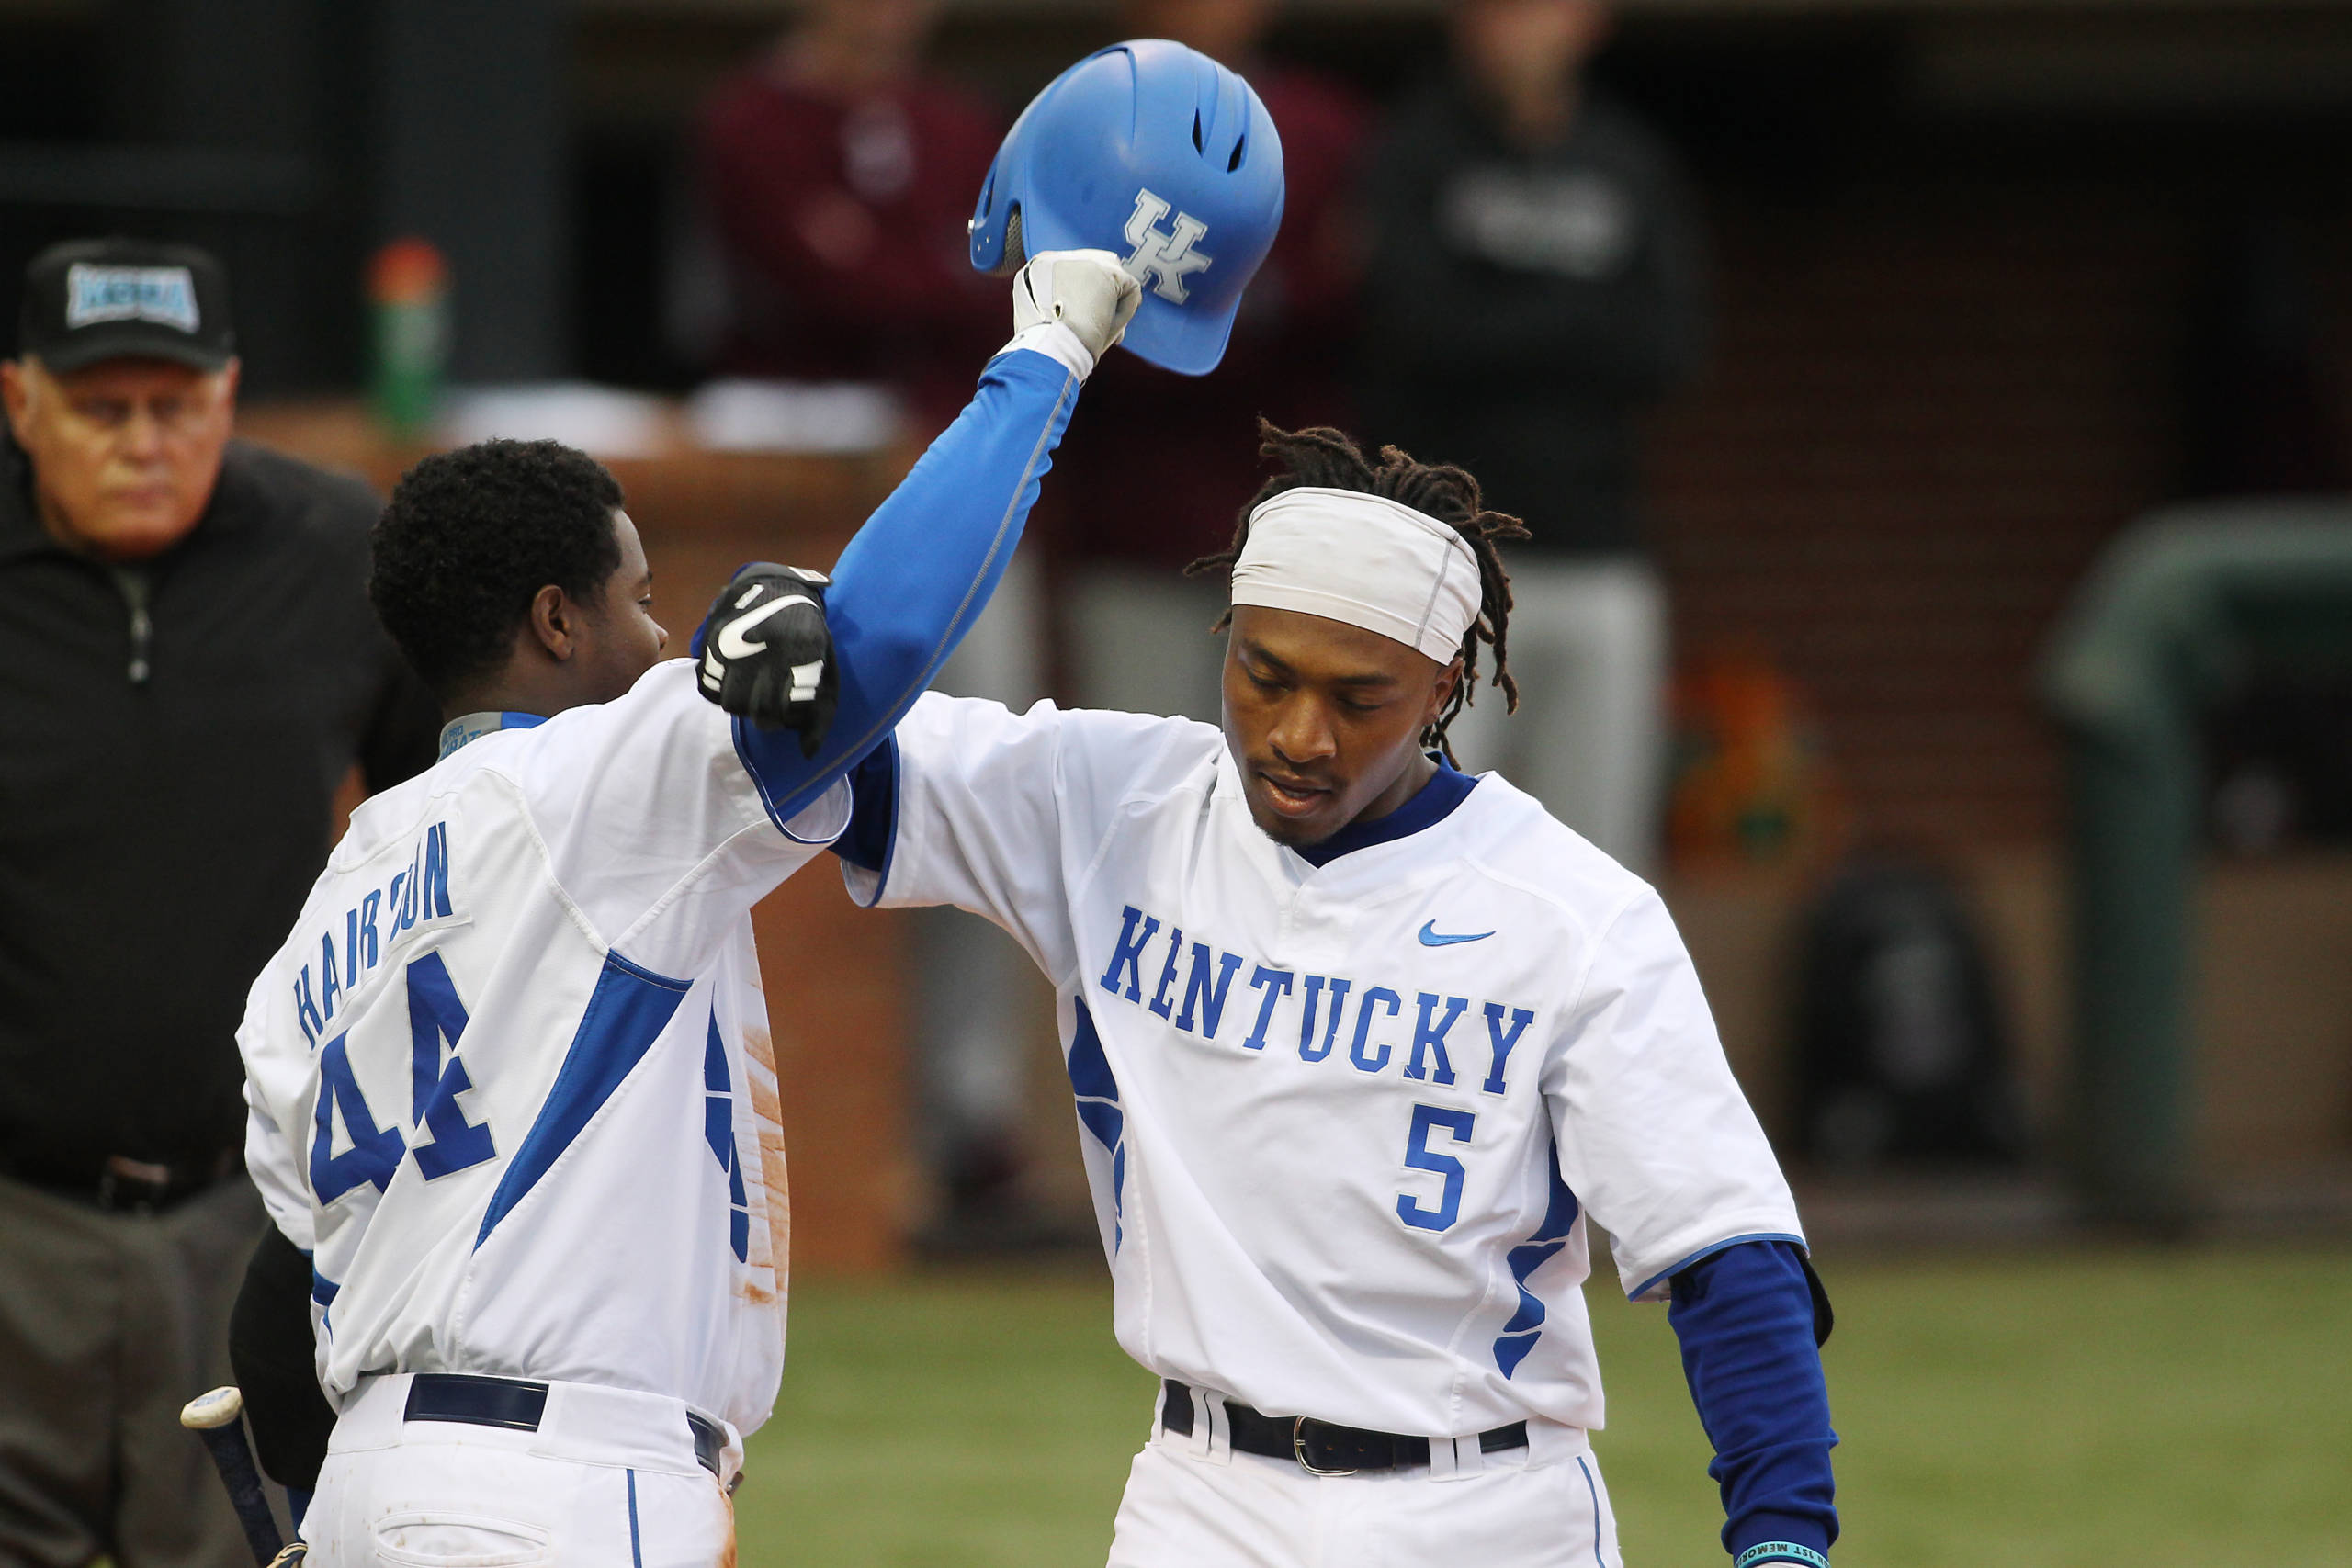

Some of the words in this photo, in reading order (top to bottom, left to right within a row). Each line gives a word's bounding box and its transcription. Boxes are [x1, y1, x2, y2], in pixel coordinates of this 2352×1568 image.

[1121, 187, 1213, 305] UK
[309, 949, 498, 1207] 44
[1099, 905, 1535, 1096] KENTUCKY
[1396, 1103, 1477, 1233] 5
